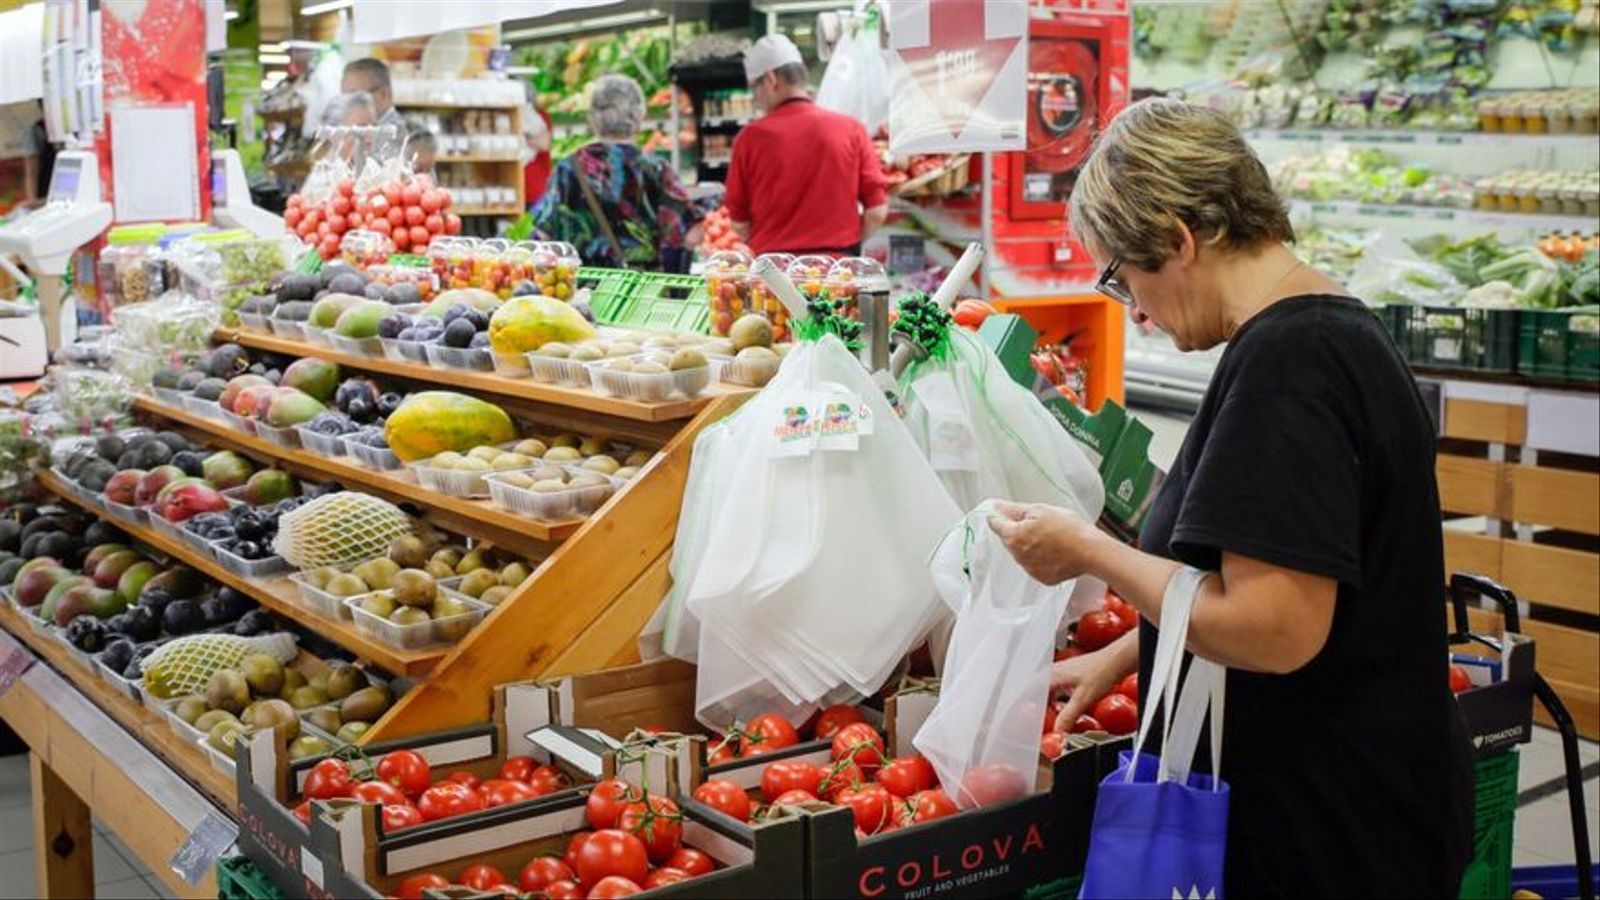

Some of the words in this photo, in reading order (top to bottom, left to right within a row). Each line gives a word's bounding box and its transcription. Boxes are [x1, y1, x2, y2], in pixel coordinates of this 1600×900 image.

[858, 822, 1044, 897] COLOVA
[934, 878, 954, 892] AND
[956, 863, 1010, 888] VEGETABLES
